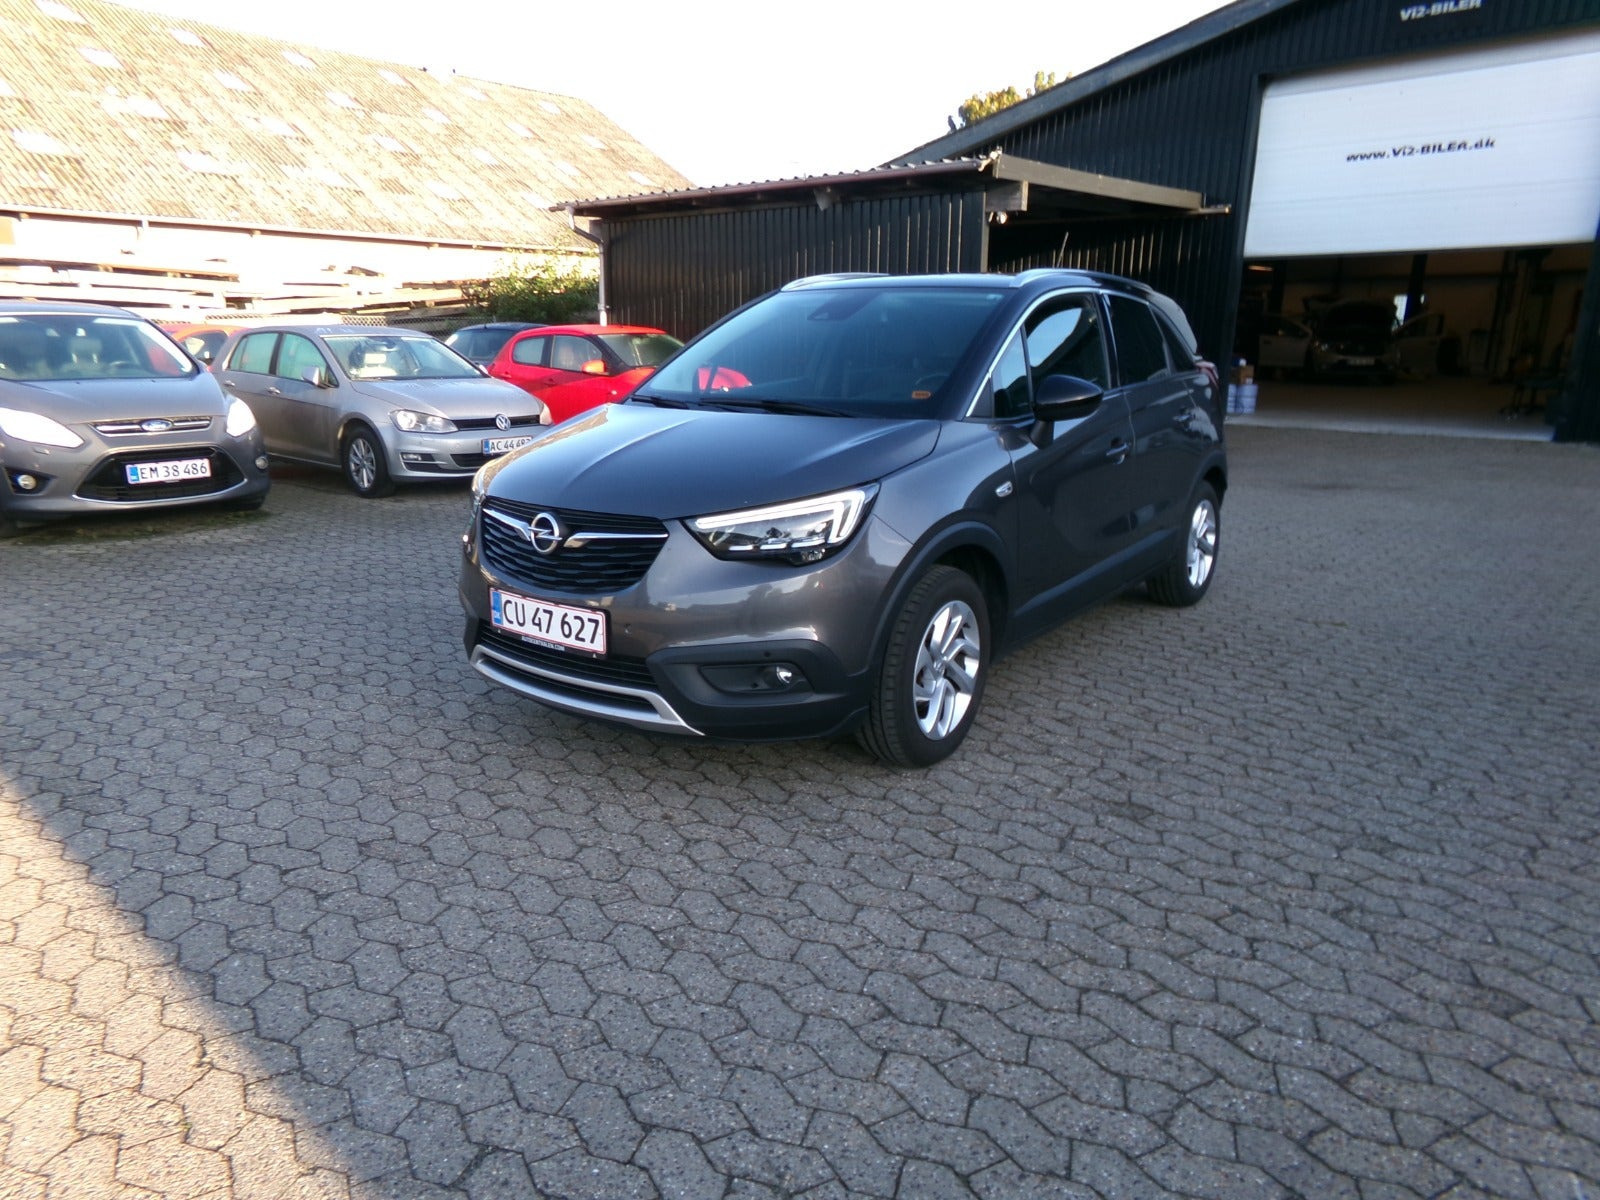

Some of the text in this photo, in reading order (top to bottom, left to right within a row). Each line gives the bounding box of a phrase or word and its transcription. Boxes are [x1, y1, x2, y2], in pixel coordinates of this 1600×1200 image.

[490, 440, 503, 451] AC
[140, 463, 207, 479] EM 38 486
[504, 600, 600, 644] CU 47 627
